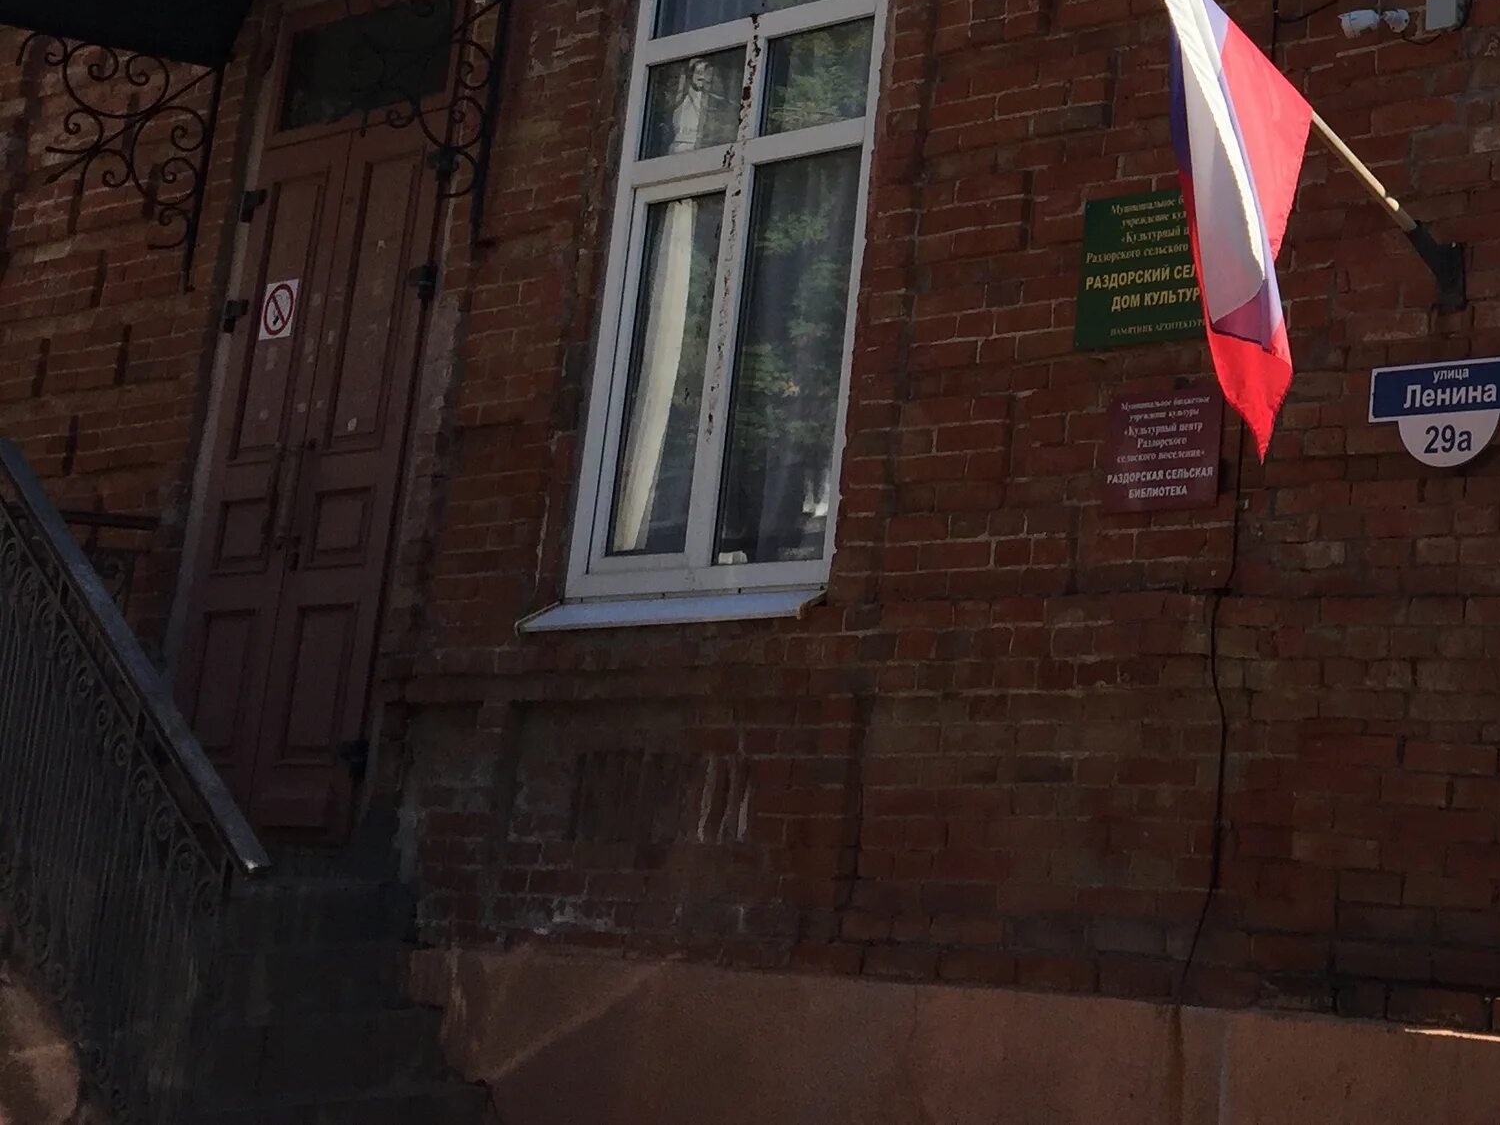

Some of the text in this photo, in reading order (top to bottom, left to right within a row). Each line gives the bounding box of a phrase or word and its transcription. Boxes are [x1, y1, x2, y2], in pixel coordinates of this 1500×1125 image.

[1085, 264, 1171, 290] РАЗДОРСКИЙ
[1111, 287, 1201, 312] ДОМ КУЛЬТУР
[1433, 368, 1470, 383] улица
[1403, 383, 1497, 409] Ленина
[1423, 424, 1473, 454] 29а
[1107, 466, 1213, 484] РАЗДОРСКАЯ СЕЛЬСКАЯ
[1128, 485, 1188, 499] БИБЛИОТЕКА
